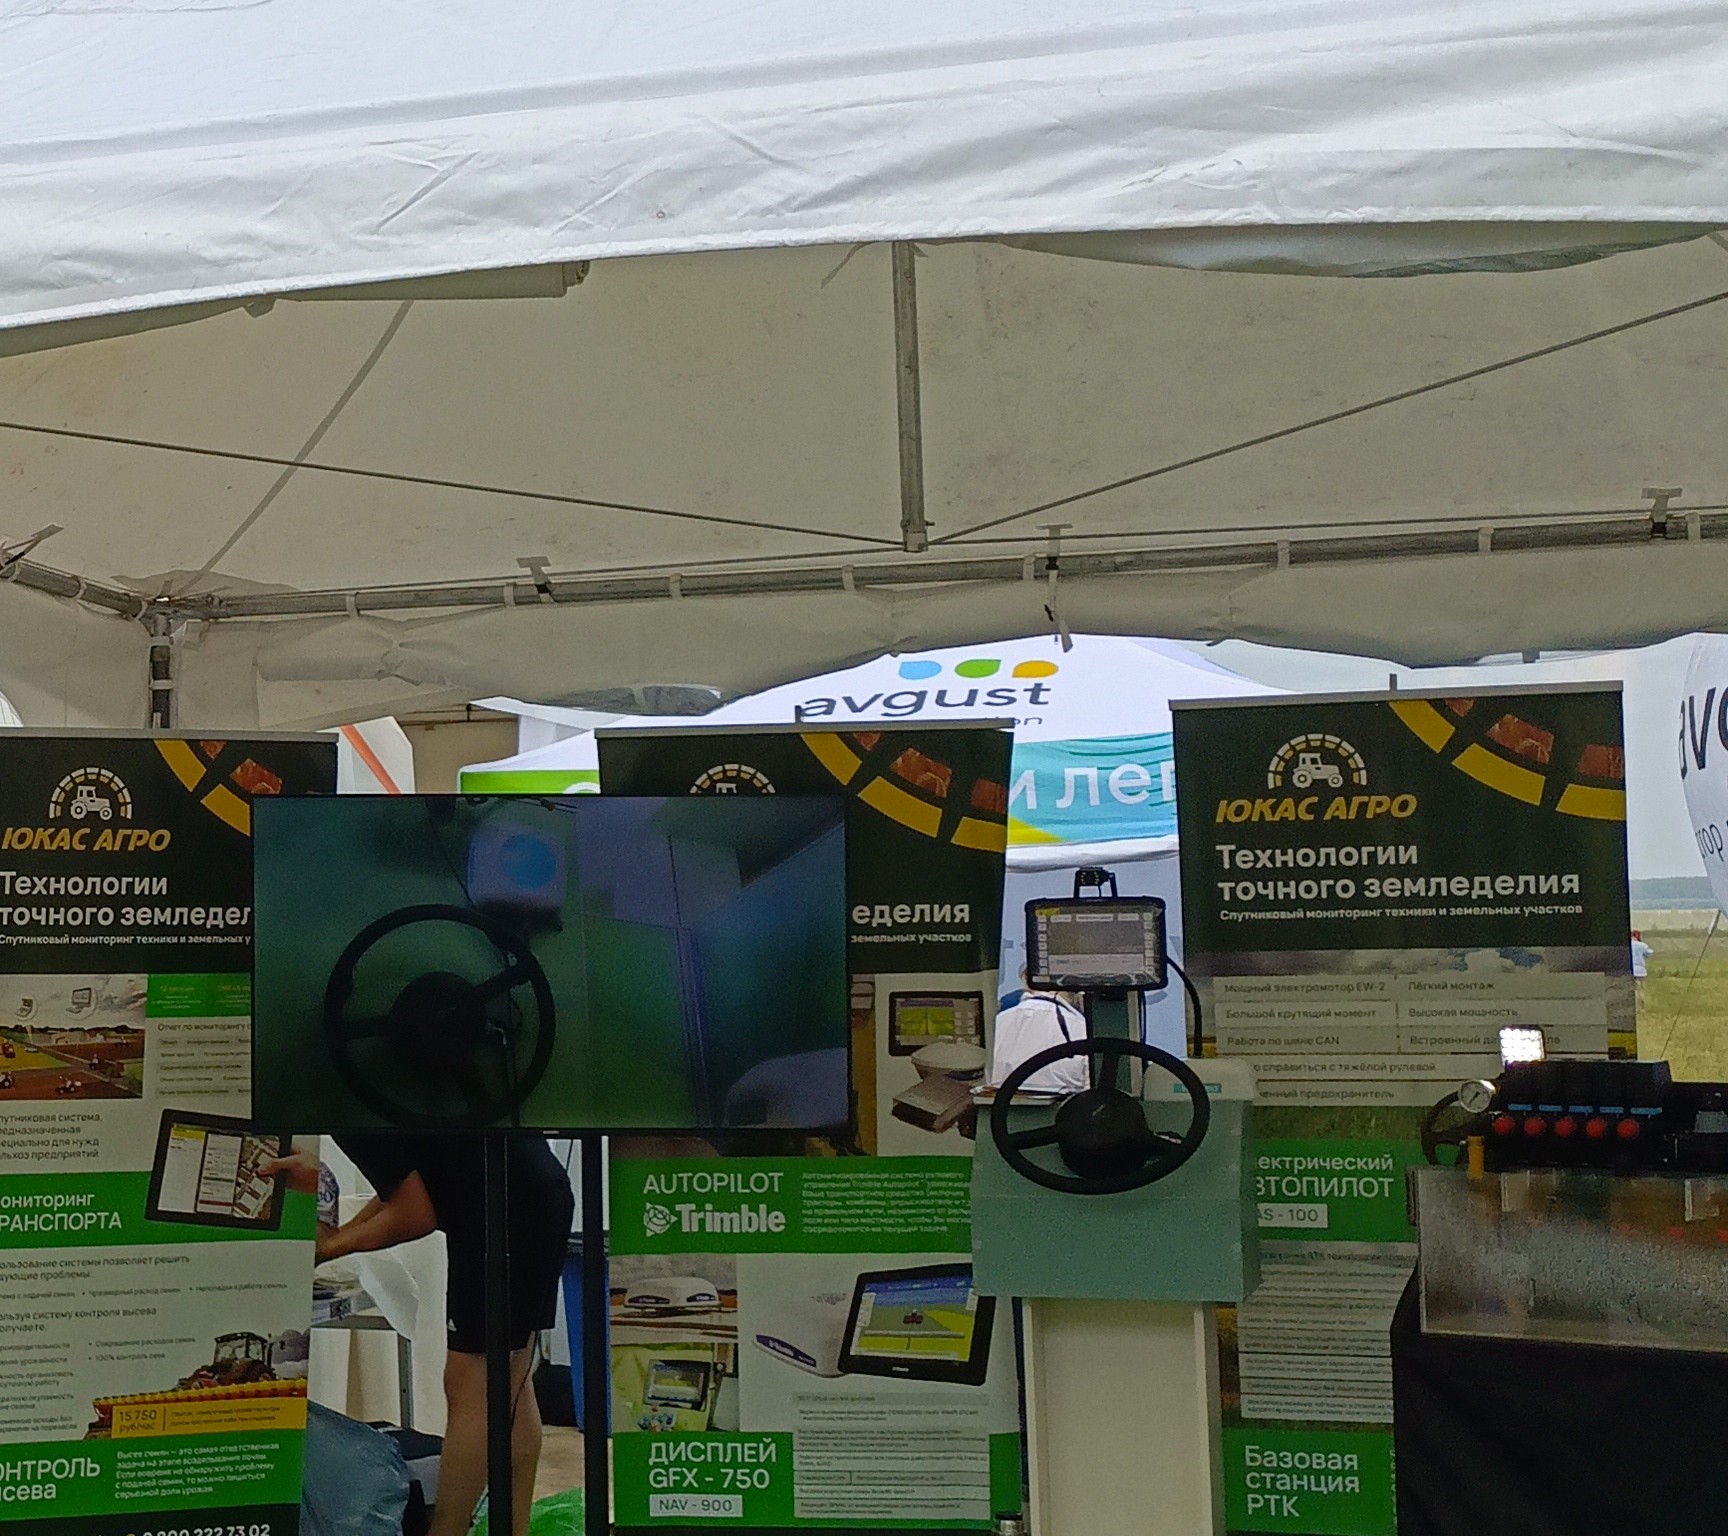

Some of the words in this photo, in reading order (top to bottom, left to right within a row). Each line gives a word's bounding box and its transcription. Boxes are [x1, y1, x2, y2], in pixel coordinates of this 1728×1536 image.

[800, 682, 1051, 718] avgust
[1215, 796, 1320, 823] ЮКАС
[1323, 794, 1418, 821] АГРО
[1, 828, 90, 850] ЮКАС
[93, 829, 171, 852] АГРО
[1216, 844, 1418, 869] Технологии
[0, 871, 168, 895] Технологии
[1218, 878, 1355, 901] точного
[1364, 873, 1580, 900] земледелия
[853, 904, 970, 927] еделия
[1220, 908, 1304, 923] Спутниковый
[1307, 908, 1382, 921] мониторинг
[1385, 907, 1436, 918] техники
[1450, 905, 1521, 916] земельных
[1524, 903, 1583, 918] участков
[72, 935, 134, 946] мониторинг
[136, 936, 178, 944] техники
[188, 935, 242, 944] земельных
[851, 934, 916, 943] земельных
[918, 934, 971, 944] участков
[1357, 982, 1385, 992] EW-2
[1409, 980, 1449, 992] Лёгкий
[1451, 981, 1495, 991] монтаж
[1226, 1008, 1276, 1019] Большой
[1278, 1008, 1332, 1020] крутящий
[1409, 1007, 1458, 1018] Высокая
[1461, 1007, 1518, 1018] мощность
[1227, 1036, 1266, 1046] Работа
[1316, 1036, 1339, 1045] CAN
[1263, 1063, 1327, 1074] справиться
[1389, 1063, 1436, 1074] рулевой
[1300, 1090, 1394, 1099] предохранитель
[52, 1138, 70, 1147] для
[72, 1138, 100, 1147] нужд
[32, 1149, 98, 1161] предприятий
[643, 1172, 784, 1194] AUTOPILOT
[675, 1203, 786, 1233] Trimble
[1288, 1208, 1319, 1222] 100
[59, 1258, 101, 1268] системы
[155, 1255, 190, 1265] решить
[33, 1310, 72, 1321] систему
[74, 1308, 121, 1318] контроля
[123, 1307, 157, 1316] высева
[120, 1411, 134, 1422] 15
[136, 1410, 157, 1421] 750
[120, 1421, 155, 1433] руб/час
[649, 1438, 776, 1465] ДИСПЛЕЙ
[1245, 1445, 1358, 1470] Базовая
[650, 1468, 699, 1488] GFX
[721, 1468, 770, 1489] 750
[1246, 1472, 1360, 1494] станция
[660, 1499, 688, 1511] NAV
[701, 1499, 732, 1511] 900
[1247, 1494, 1300, 1517] РТК
